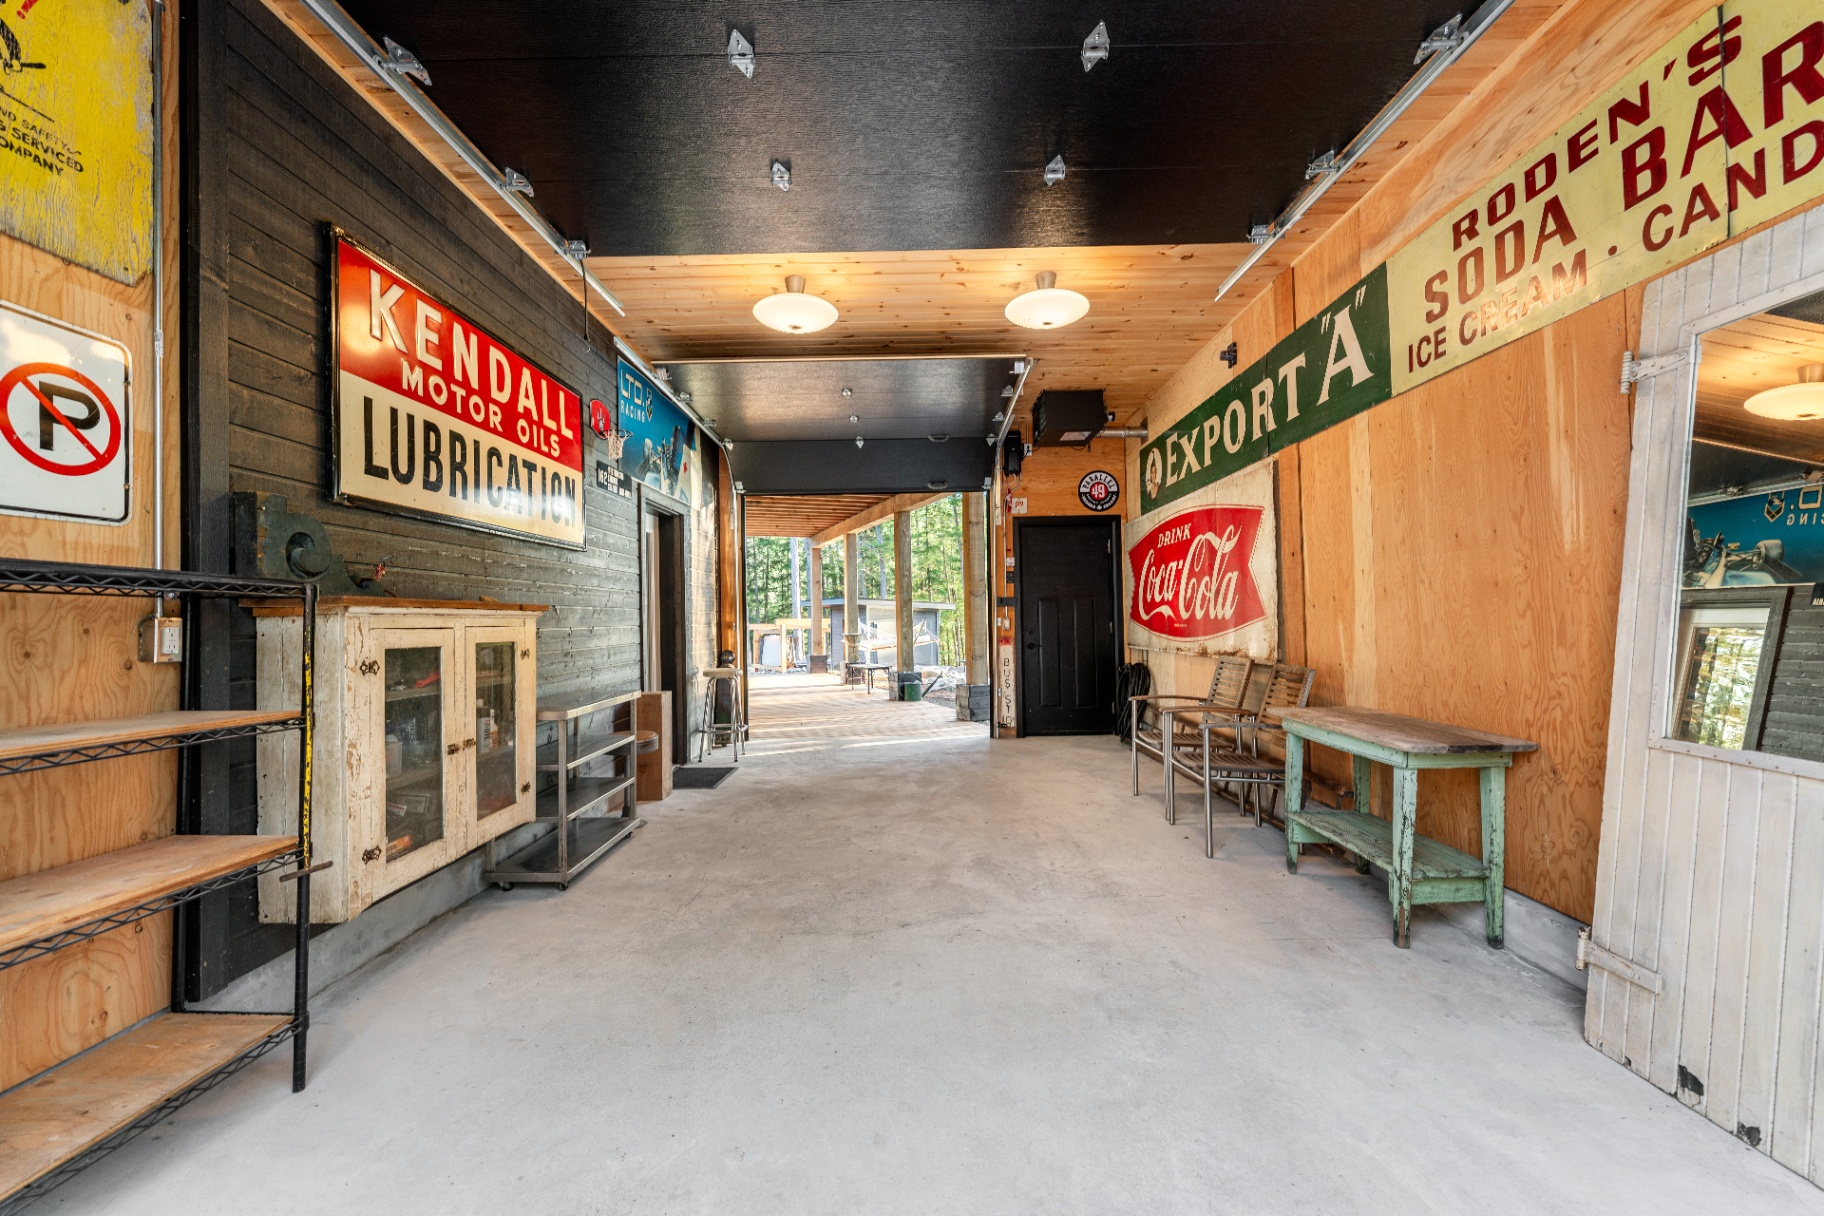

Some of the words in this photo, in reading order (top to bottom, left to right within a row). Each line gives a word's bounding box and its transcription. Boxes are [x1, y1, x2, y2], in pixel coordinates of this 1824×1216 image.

[11, 127, 84, 172] SERVICED
[22, 119, 68, 149] SAFETY
[1425, 195, 1577, 324] SODA
[1621, 21, 1824, 211] BAR
[1453, 15, 1742, 252] RODEN'S
[369, 268, 574, 440] KENDALL
[1409, 326, 1447, 373] ICE
[1459, 248, 1588, 346] CREAM
[401, 358, 503, 432] MOTOR
[517, 420, 560, 459] OILS
[620, 400, 645, 423] RACING
[1165, 352, 1306, 488] EXPORT
[363, 395, 577, 529] LUBRICATION
[1091, 483, 1106, 499] 49
[1138, 522, 1243, 621] Coca-Cola
[1157, 523, 1192, 549] DRINK
